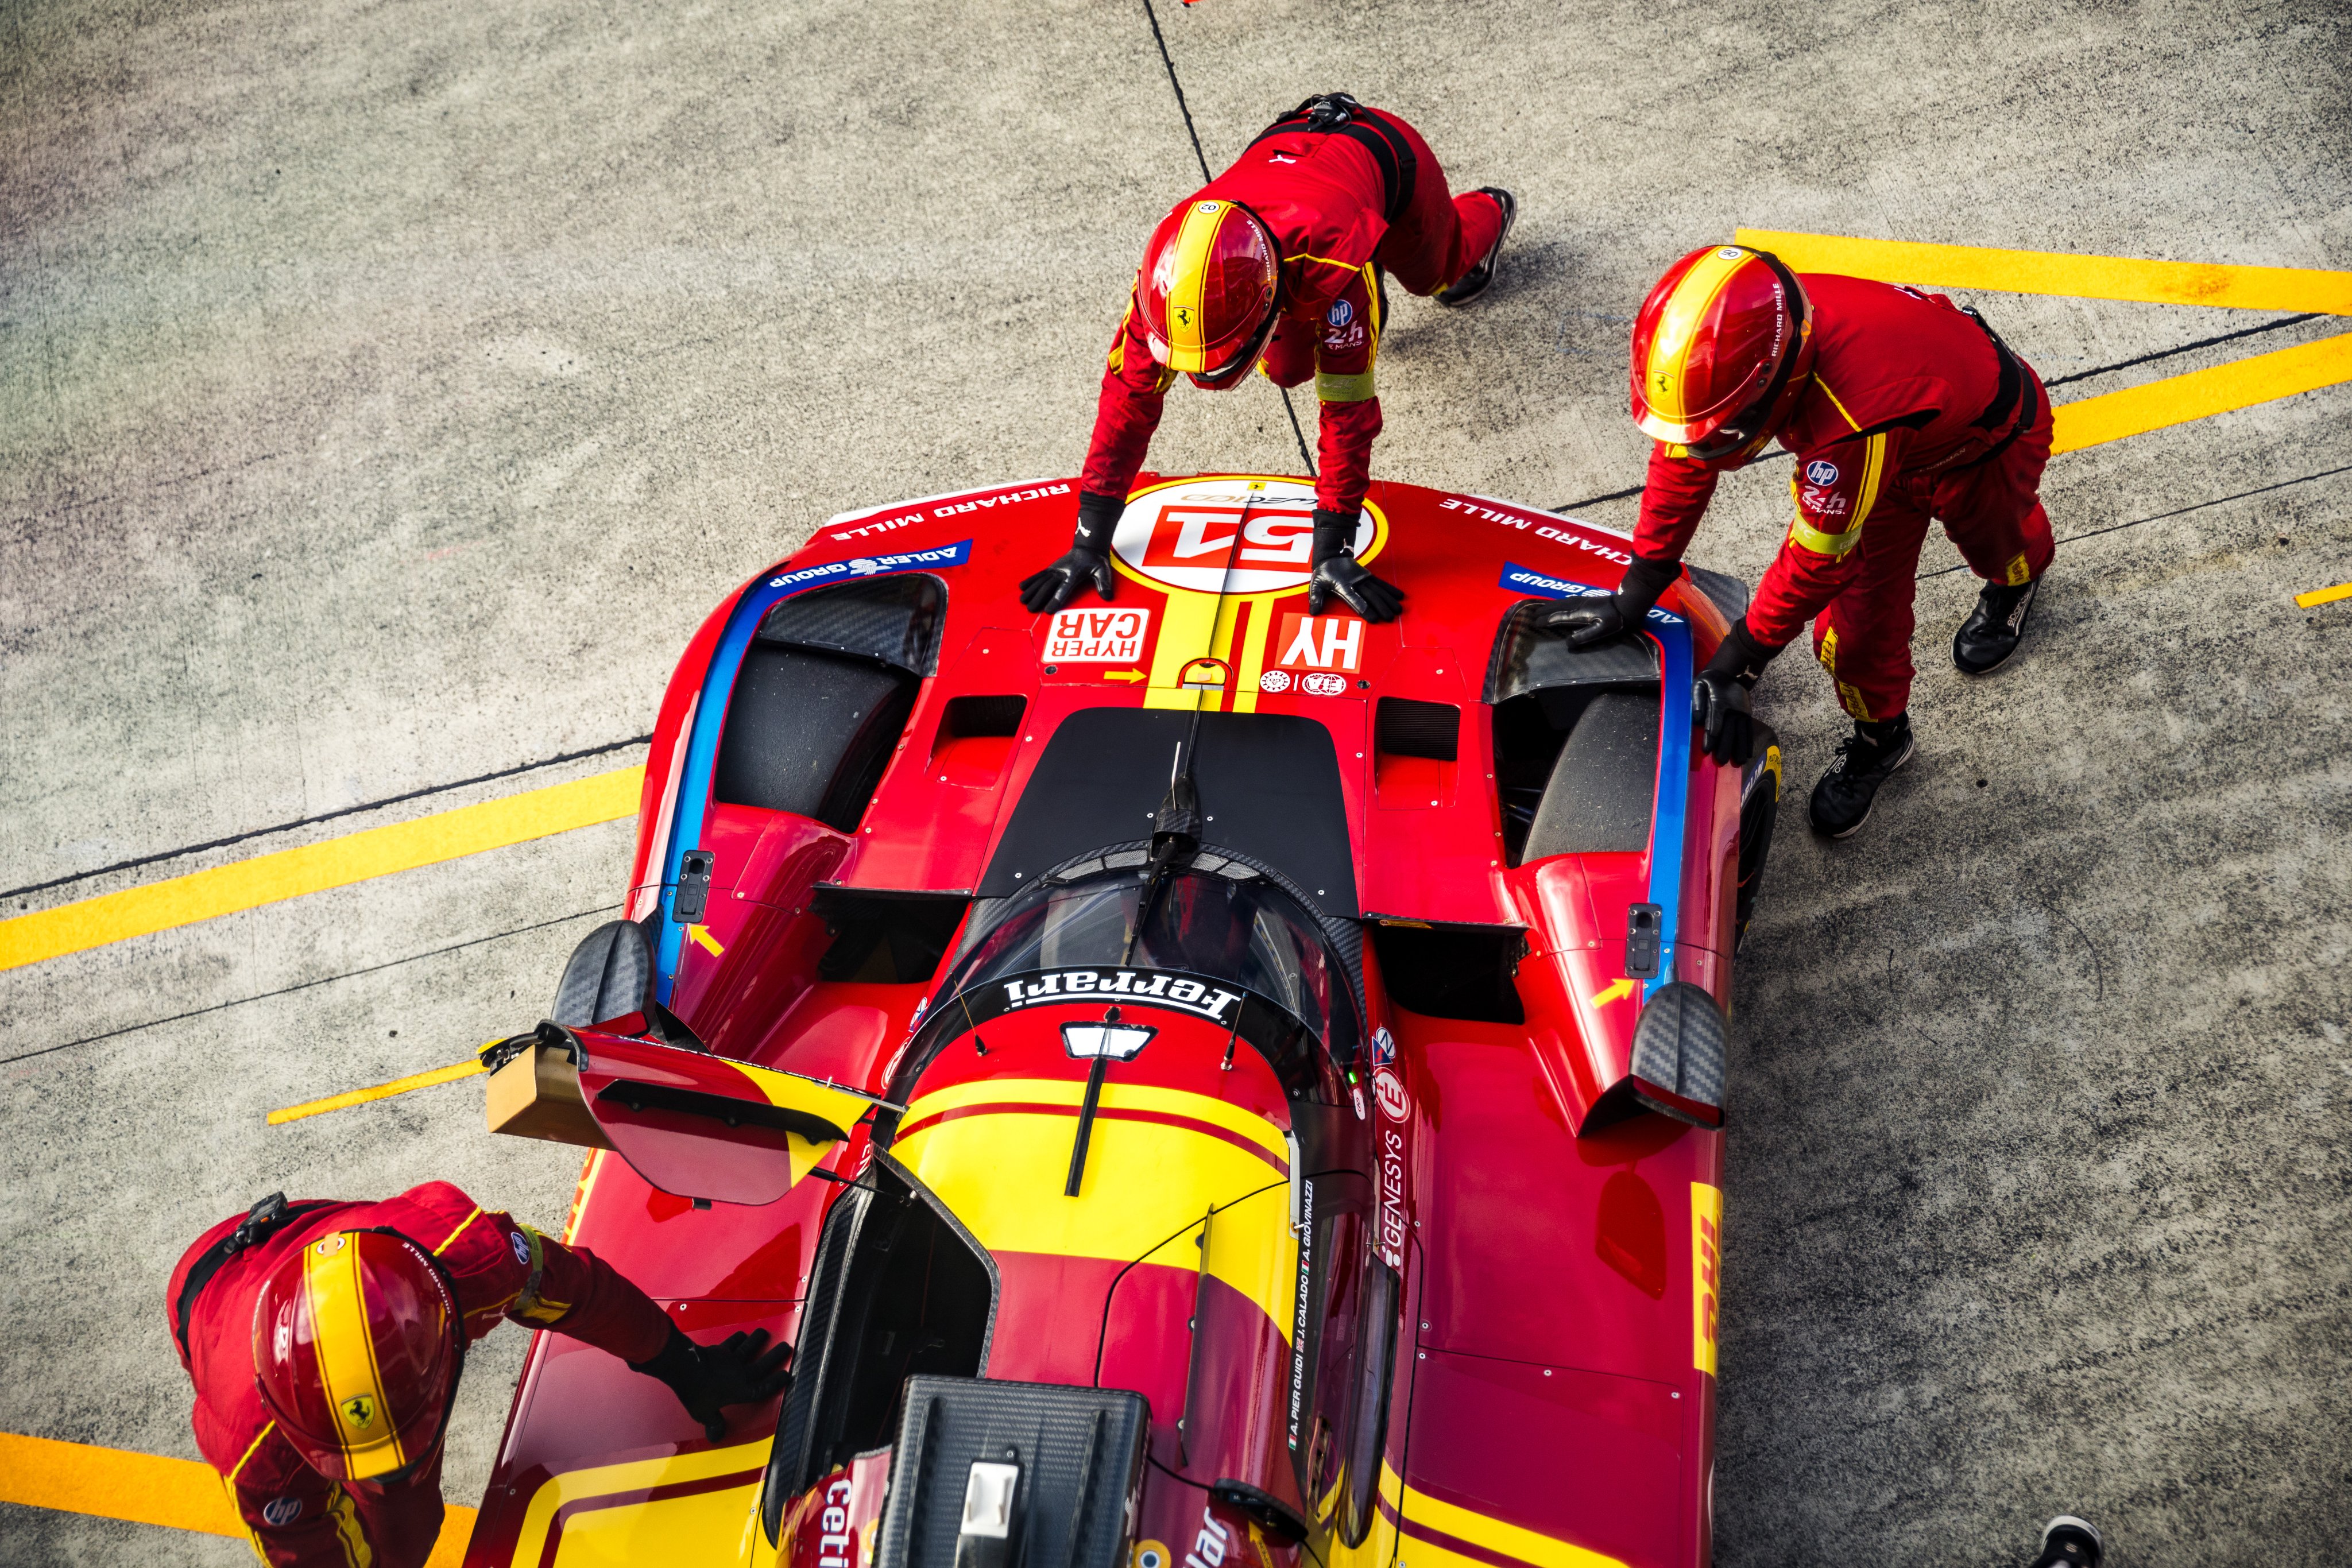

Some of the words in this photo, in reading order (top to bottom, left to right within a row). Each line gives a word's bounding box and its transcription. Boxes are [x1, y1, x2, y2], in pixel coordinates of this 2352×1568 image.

[1246, 219, 1263, 242] MILLE
[1262, 243, 1271, 281] RICHARD
[1772, 282, 1783, 311] MILLE
[1771, 314, 1783, 357] RICHARD
[1810, 461, 1836, 486] hp
[934, 483, 1071, 518] RICHARD
[1438, 498, 1531, 531] MILLE
[830, 513, 924, 541] MILLE
[1166, 511, 1315, 564] 51
[876, 546, 957, 566] ADLER
[1534, 526, 1633, 566] CHARD
[769, 563, 848, 588] GROUP
[1510, 572, 1587, 593] GROUP
[1057, 613, 1141, 639] CAR
[1051, 640, 1136, 657] HYPER
[1280, 617, 1362, 670] HY
[1004, 971, 1241, 1020] Ferrari
[1384, 1129, 1402, 1248] GENESYS
[1303, 1179, 1313, 1248] GIOVINAZZI
[402, 1242, 429, 1267] MILLE
[1302, 1248, 1310, 1261] A.
[1298, 1274, 1309, 1327] CALADO
[1297, 1328, 1305, 1339] J.
[1293, 1353, 1303, 1390] GUIDI
[1291, 1389, 1301, 1421] PIER
[1290, 1421, 1298, 1436] A.
[269, 1497, 299, 1525] hp
